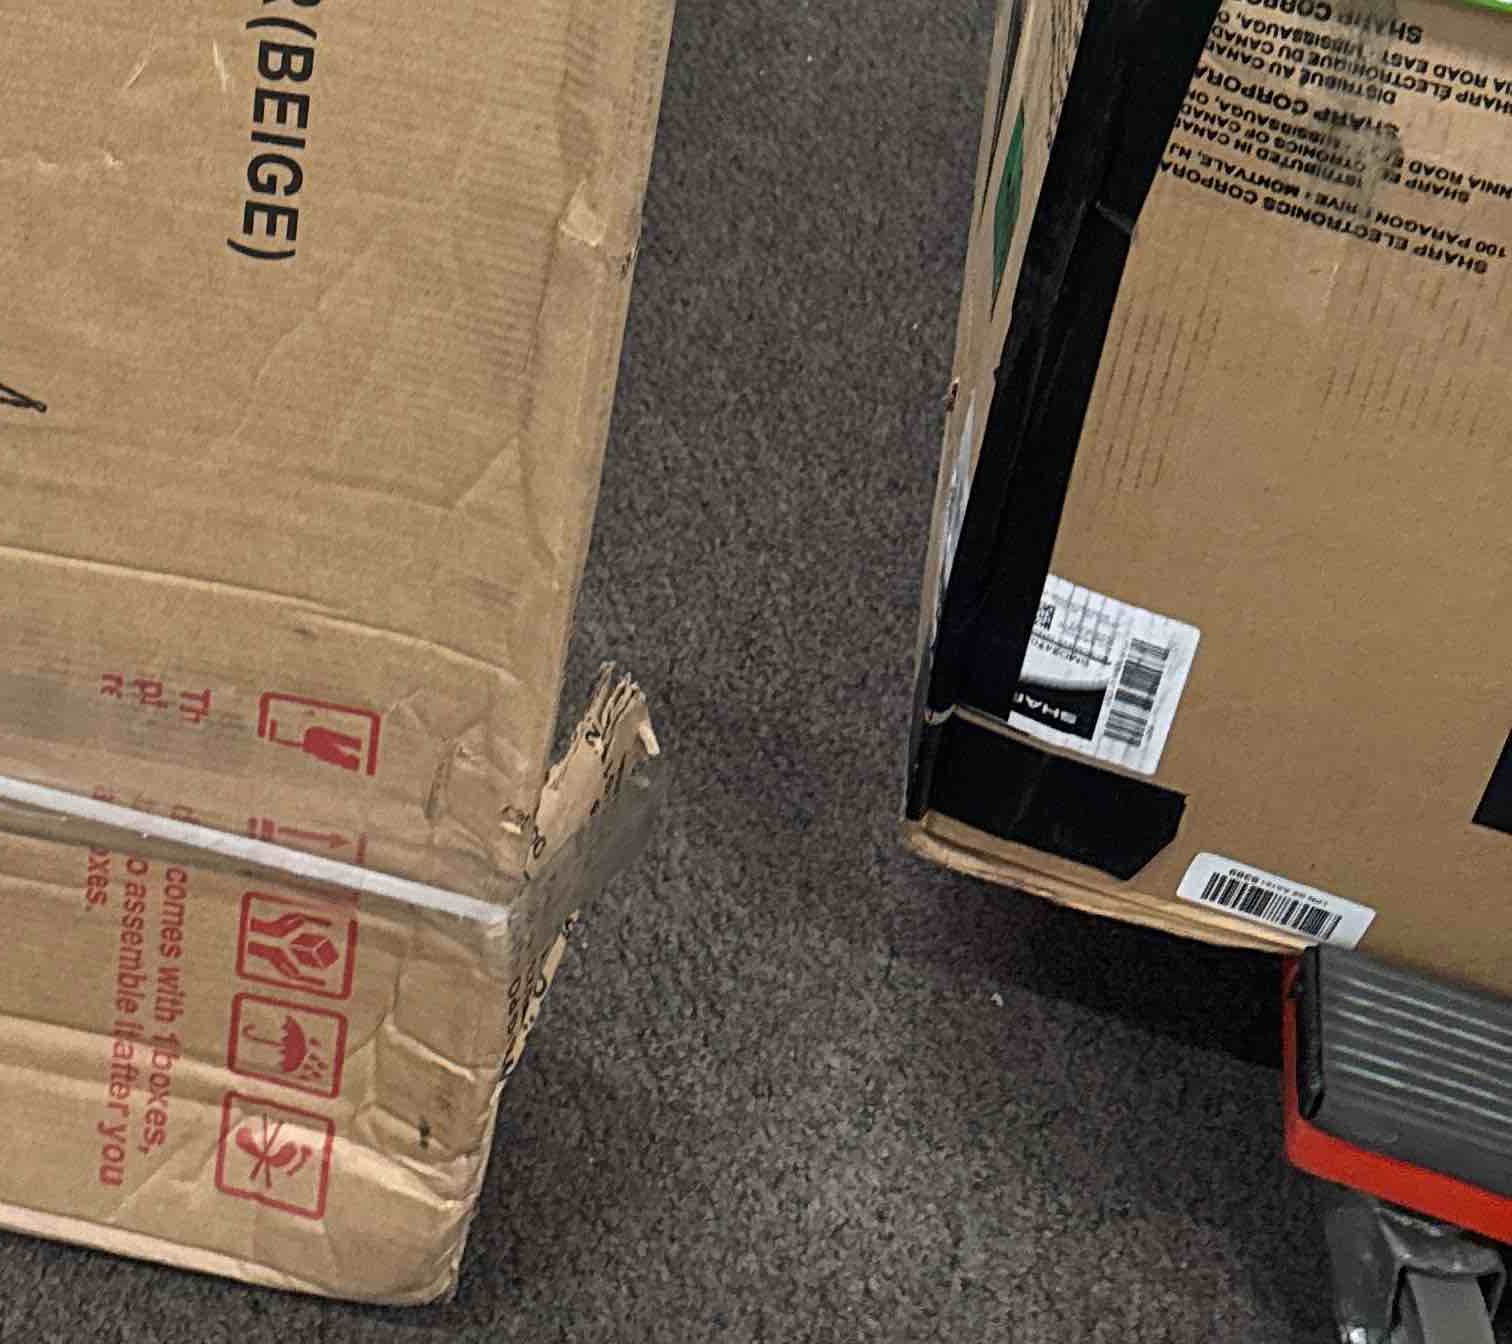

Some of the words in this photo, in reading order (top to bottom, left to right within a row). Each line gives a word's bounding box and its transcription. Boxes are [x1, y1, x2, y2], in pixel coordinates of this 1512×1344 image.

[1278, 44, 1305, 62] DU
[1381, 49, 1430, 74] EAST
[1269, 62, 1292, 80] AU
[1433, 63, 1489, 90] ROAD
[1233, 140, 1254, 157] IN
[1244, 128, 1270, 144] OF
[1197, 150, 1300, 198] MONTVALE,
[1256, 146, 1363, 190] ISTRIBUTED
[1408, 159, 1463, 185] ROAD
[1405, 176, 1470, 205] SHARP
[1264, 196, 1409, 252] ELECTRONICS
[1375, 210, 1471, 249] PARAGON
[1413, 244, 1489, 275] SHARP
[1476, 239, 1507, 259] 100
[159, 867, 187, 960] comes
[114, 883, 148, 1013] assemble
[154, 967, 185, 1023] with
[97, 1120, 126, 1187] you
